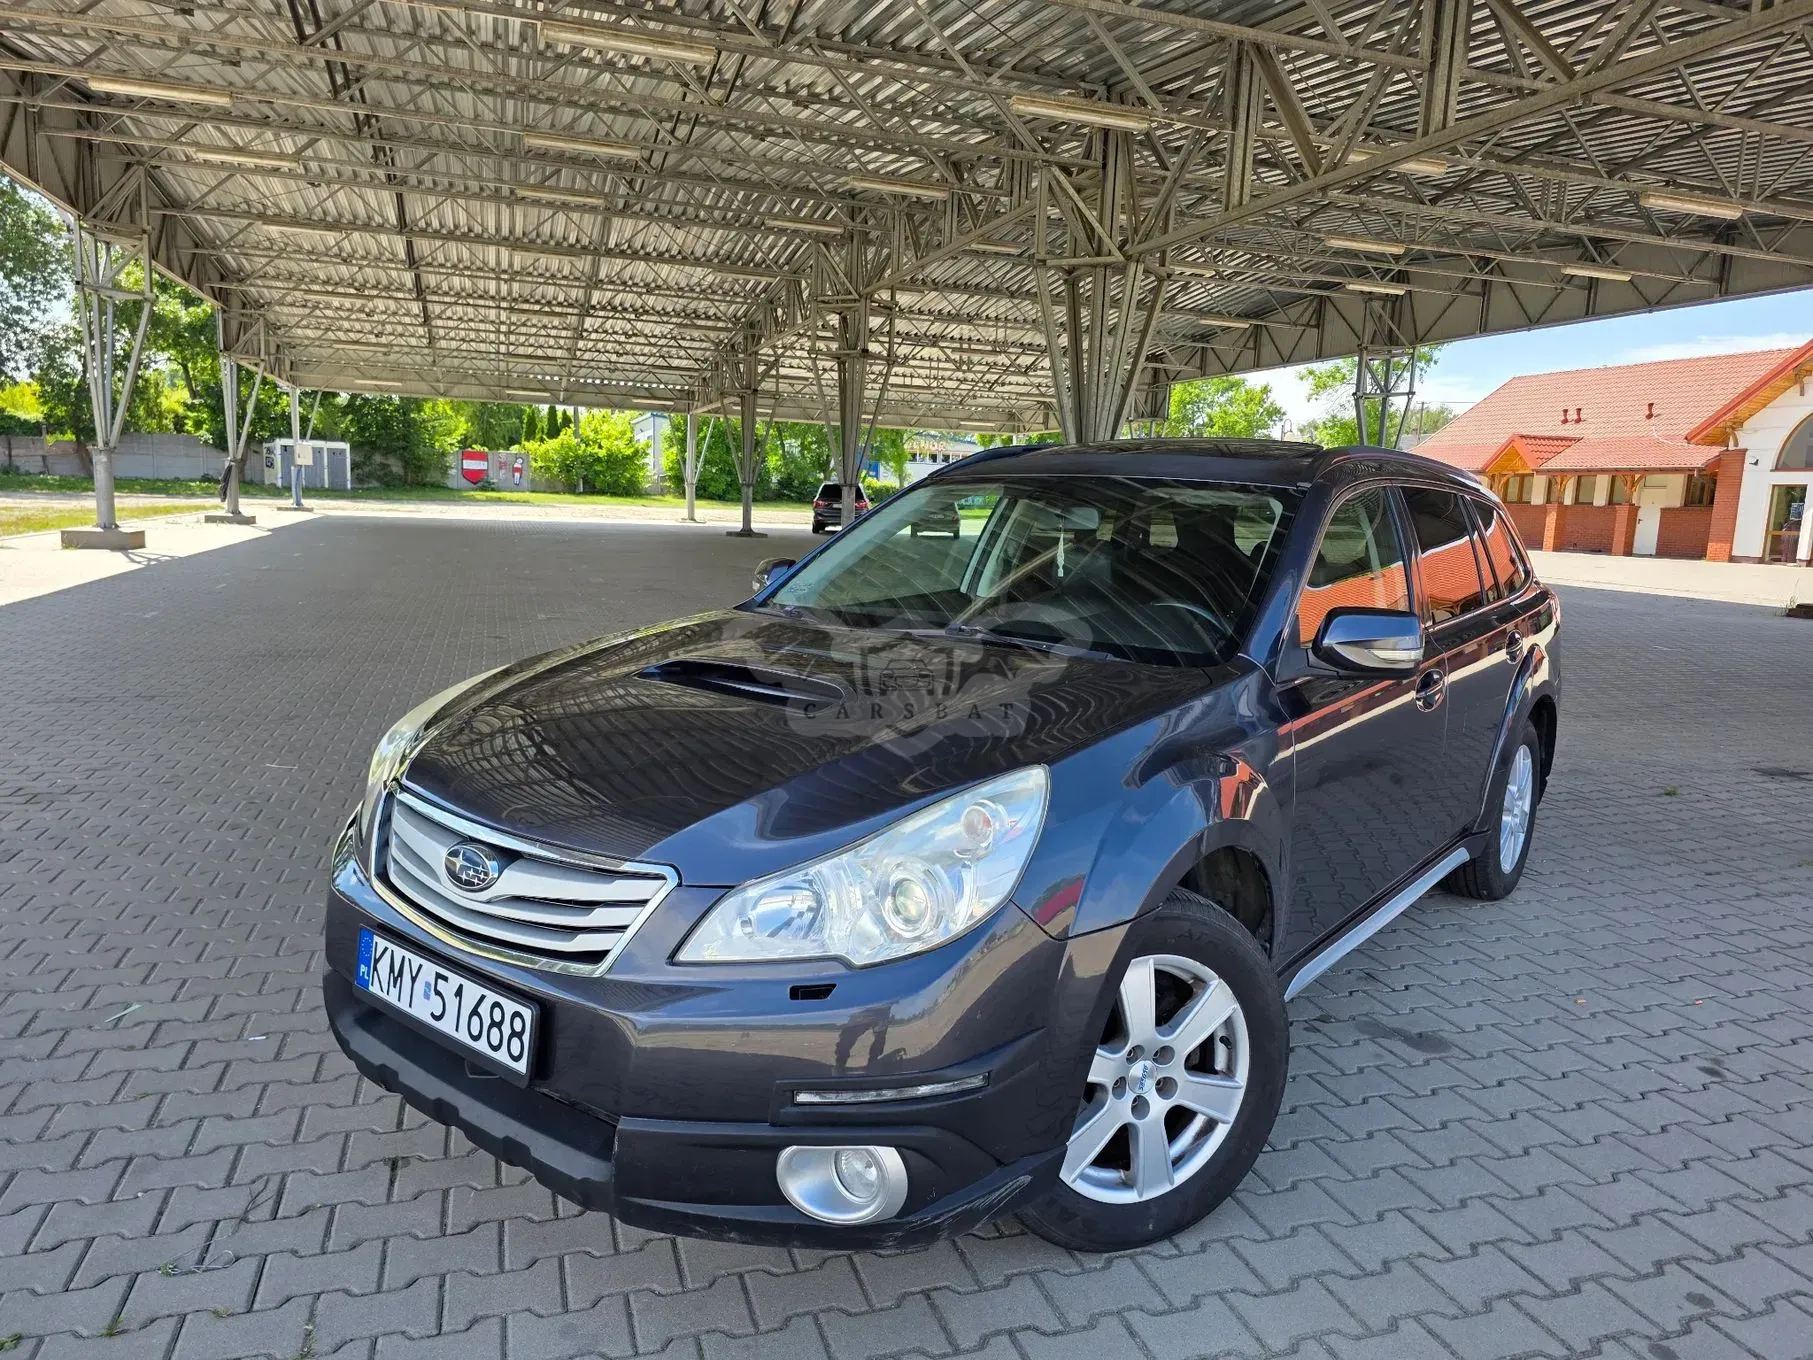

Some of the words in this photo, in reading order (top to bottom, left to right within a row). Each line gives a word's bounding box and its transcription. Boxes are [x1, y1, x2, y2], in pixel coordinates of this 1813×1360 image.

[360, 963, 369, 980] PL
[371, 941, 423, 1009] KMY
[430, 970, 526, 1063] 51688
